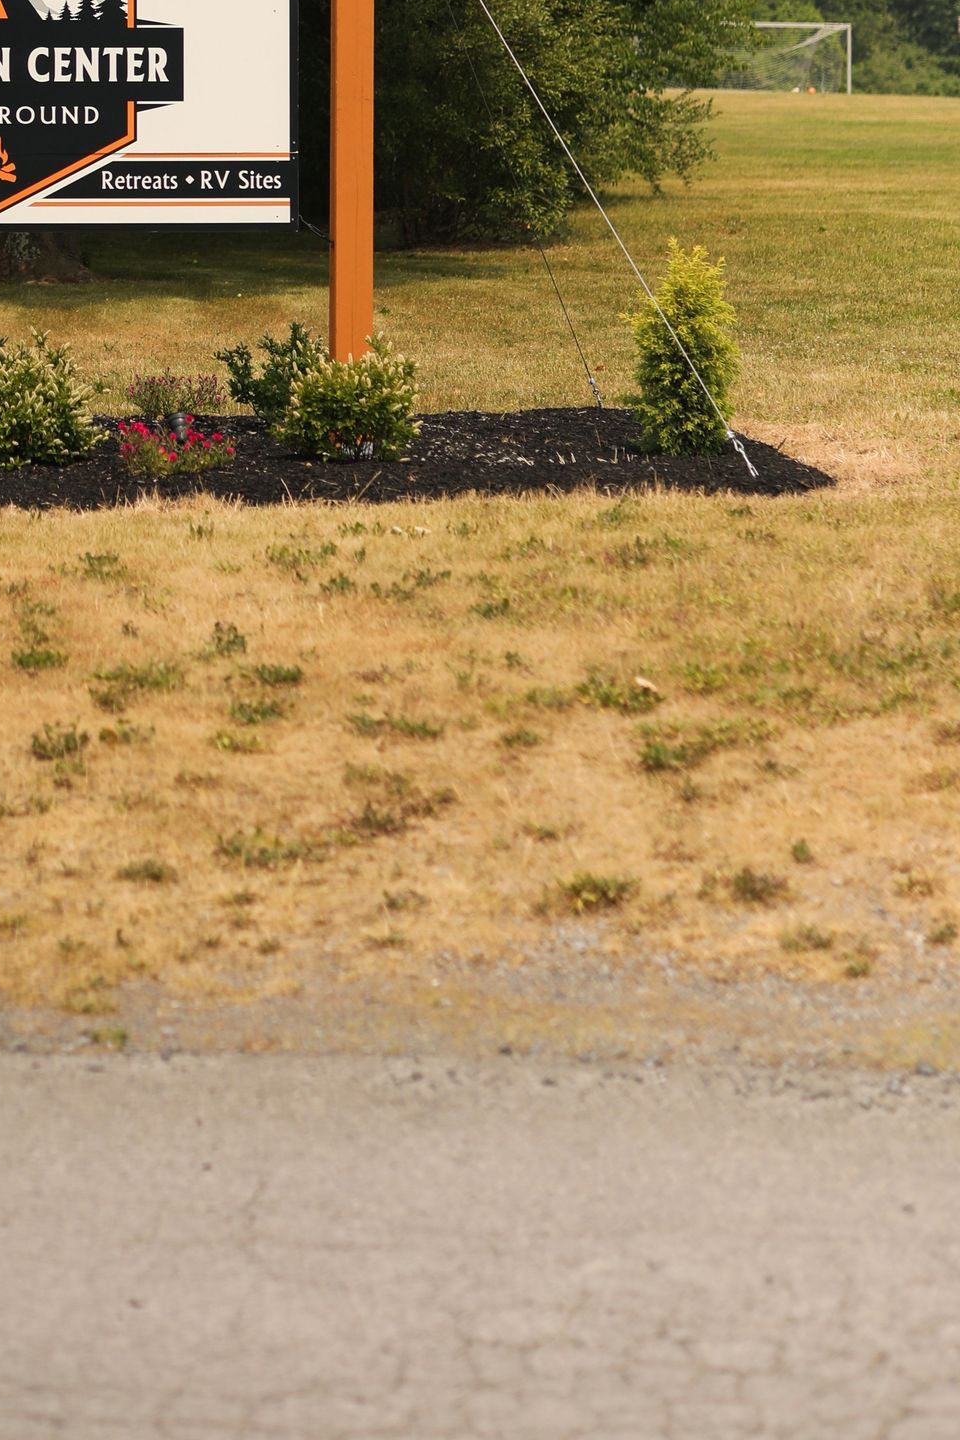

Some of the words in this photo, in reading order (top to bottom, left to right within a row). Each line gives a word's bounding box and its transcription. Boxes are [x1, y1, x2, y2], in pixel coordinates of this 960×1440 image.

[27, 46, 170, 83] CENTER
[100, 170, 179, 190] Retreats
[200, 170, 231, 190] RV
[238, 169, 282, 190] Sites
